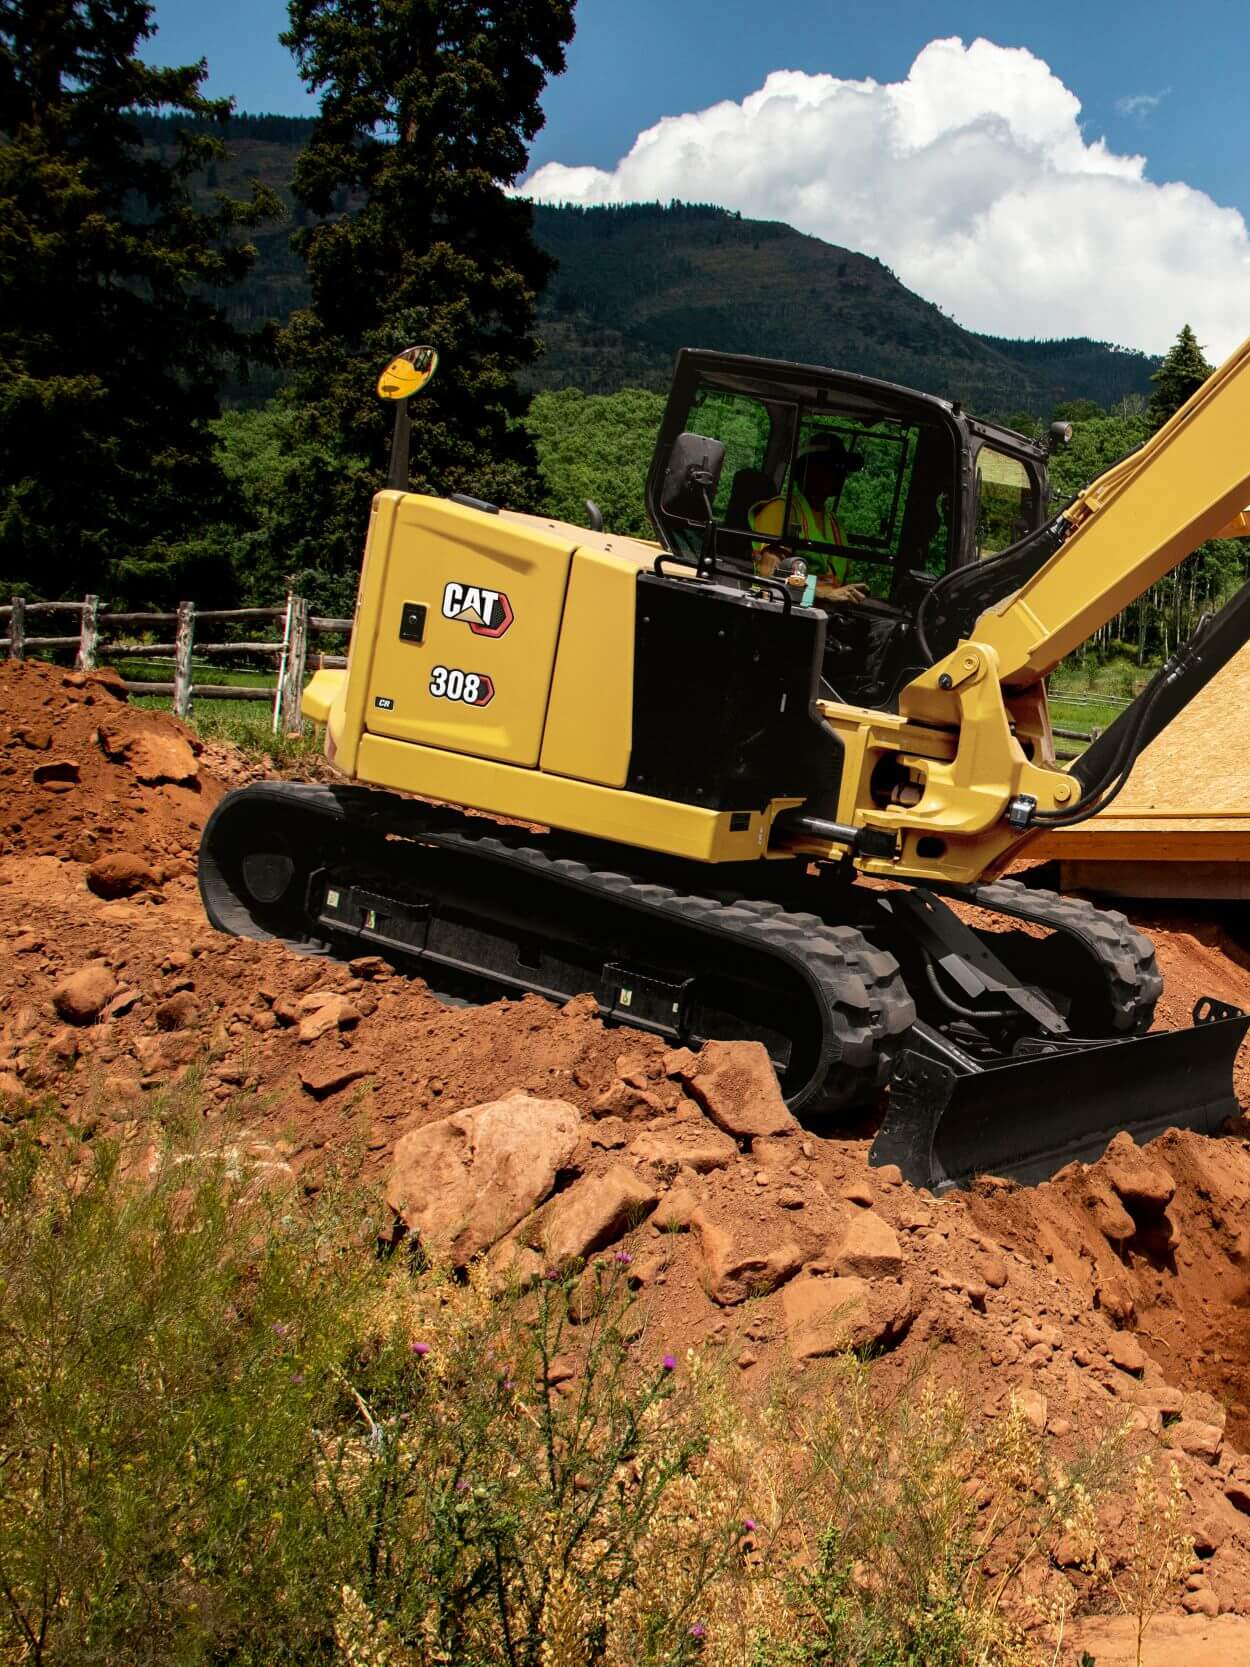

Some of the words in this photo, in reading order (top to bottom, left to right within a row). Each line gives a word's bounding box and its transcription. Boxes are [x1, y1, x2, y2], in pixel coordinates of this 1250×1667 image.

[442, 582, 499, 626] CAT
[429, 666, 481, 703] 308
[379, 699, 391, 708] CR
